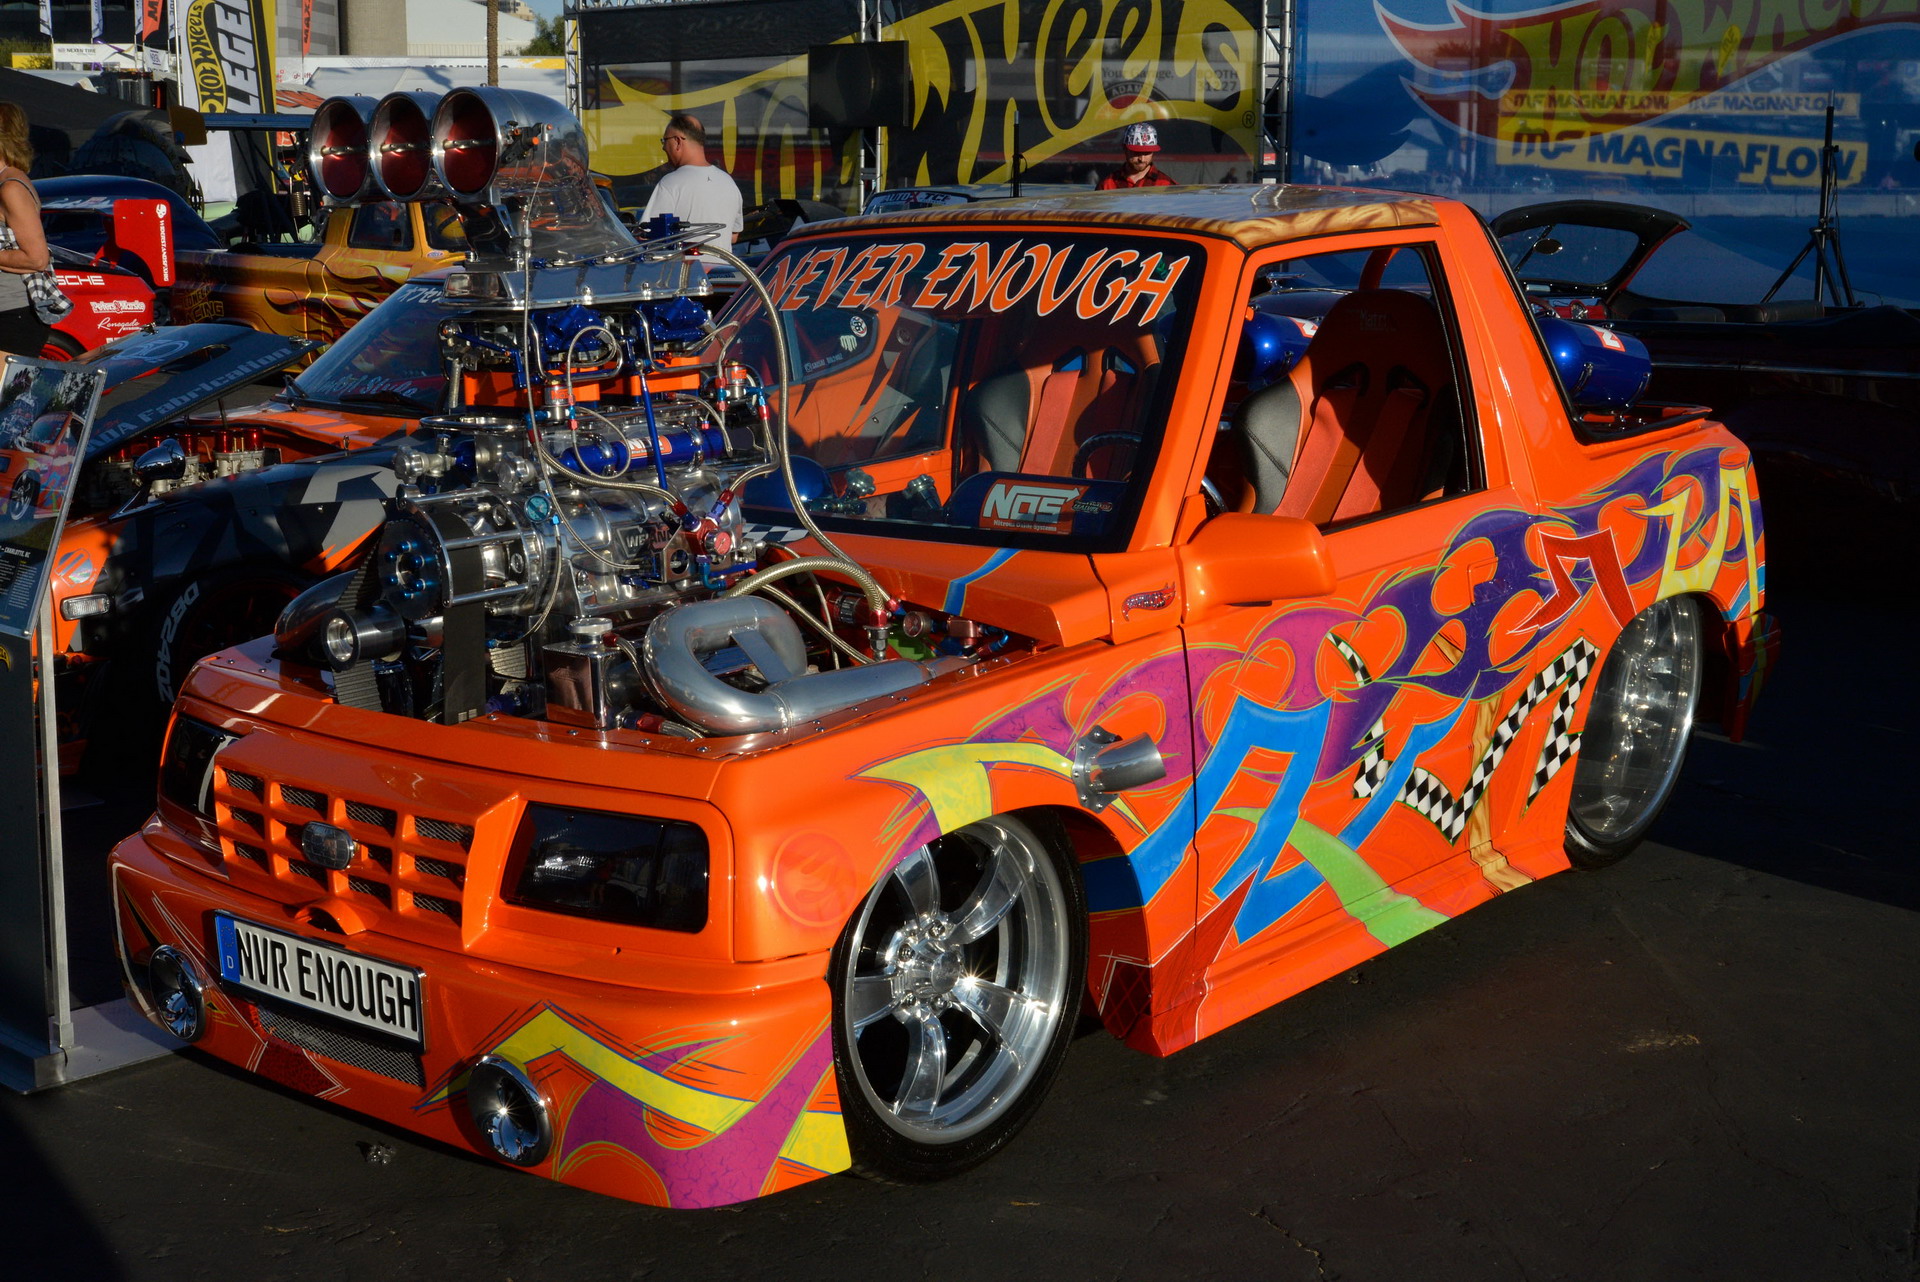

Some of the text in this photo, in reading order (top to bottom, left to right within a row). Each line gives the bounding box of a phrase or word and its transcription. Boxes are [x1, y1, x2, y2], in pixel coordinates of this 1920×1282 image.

[1549, 94, 1671, 111] MAGNAFLOW
[55, 275, 105, 286] SCHE
[752, 239, 1191, 327] NEVER ENOUGH
[97, 316, 140, 334] Renegade
[137, 347, 294, 422] Fabrication
[982, 484, 1080, 523] NOS
[1033, 524, 1057, 532] Systems
[226, 955, 234, 969] D
[235, 927, 419, 1032] NVR ENOUGH
